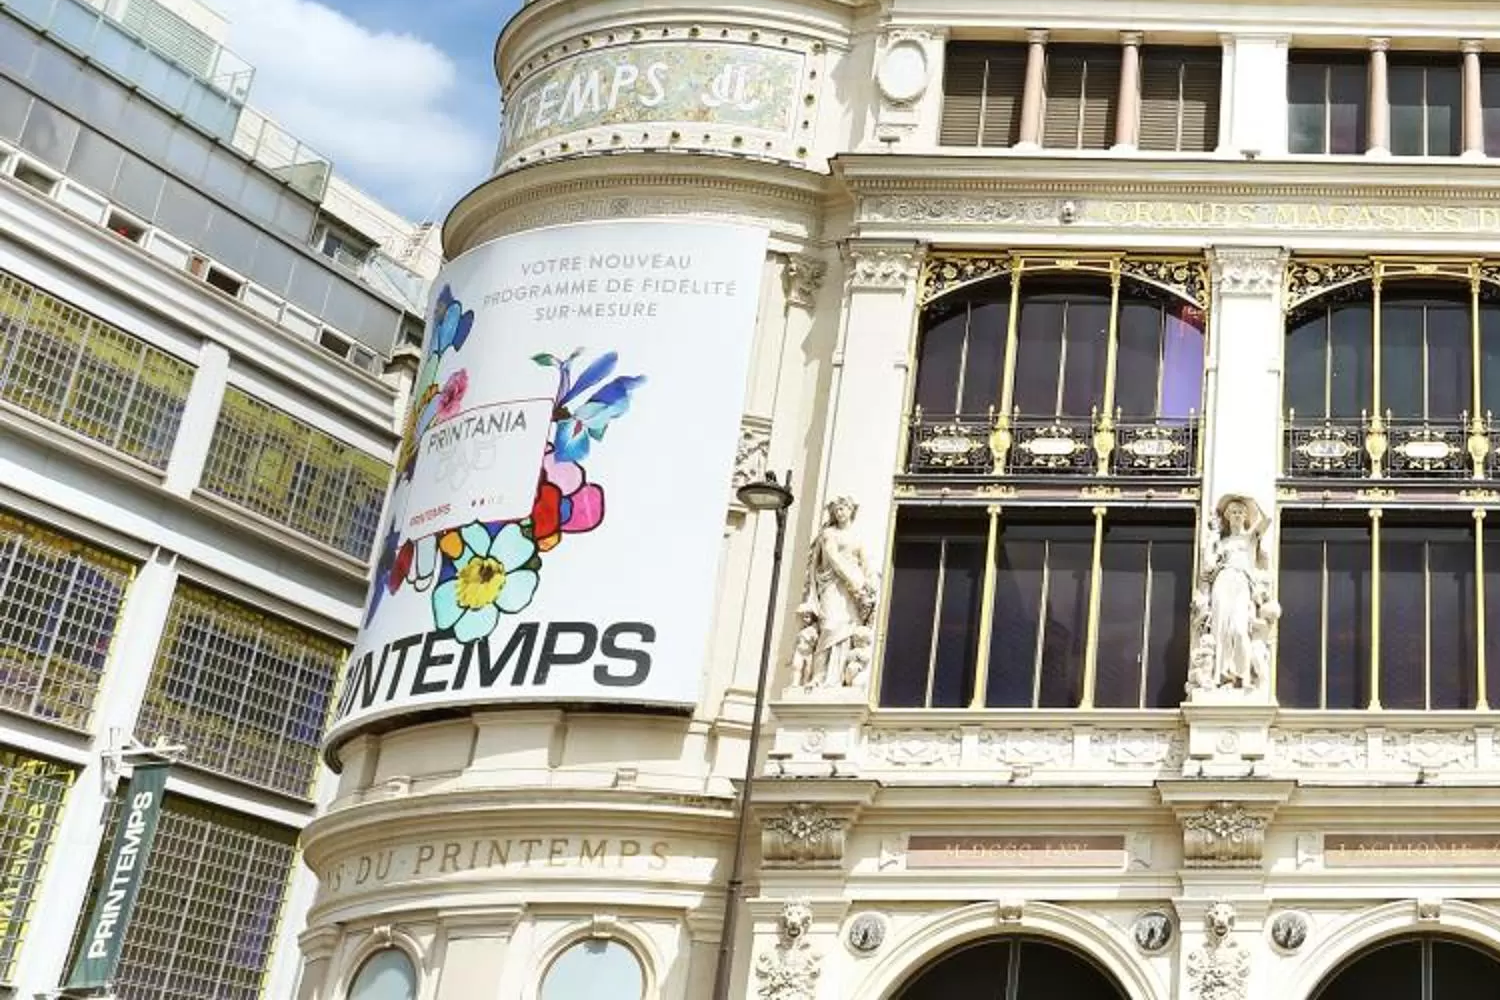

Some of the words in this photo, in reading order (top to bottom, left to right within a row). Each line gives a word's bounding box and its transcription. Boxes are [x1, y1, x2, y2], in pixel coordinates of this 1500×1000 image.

[1105, 201, 1254, 227] GRANDS
[1273, 204, 1462, 230] MAGASINS
[520, 256, 582, 277] VOTRE
[589, 253, 692, 270] NOUVEAU
[483, 278, 599, 307] PROGRAMME
[606, 277, 635, 294] DE
[535, 301, 658, 321] SUR-MESURE
[427, 410, 528, 455] PRINTANIA
[87, 790, 153, 960] PRINTEMPS
[355, 850, 396, 886] DU
[413, 838, 672, 876] PRINTEMPS
